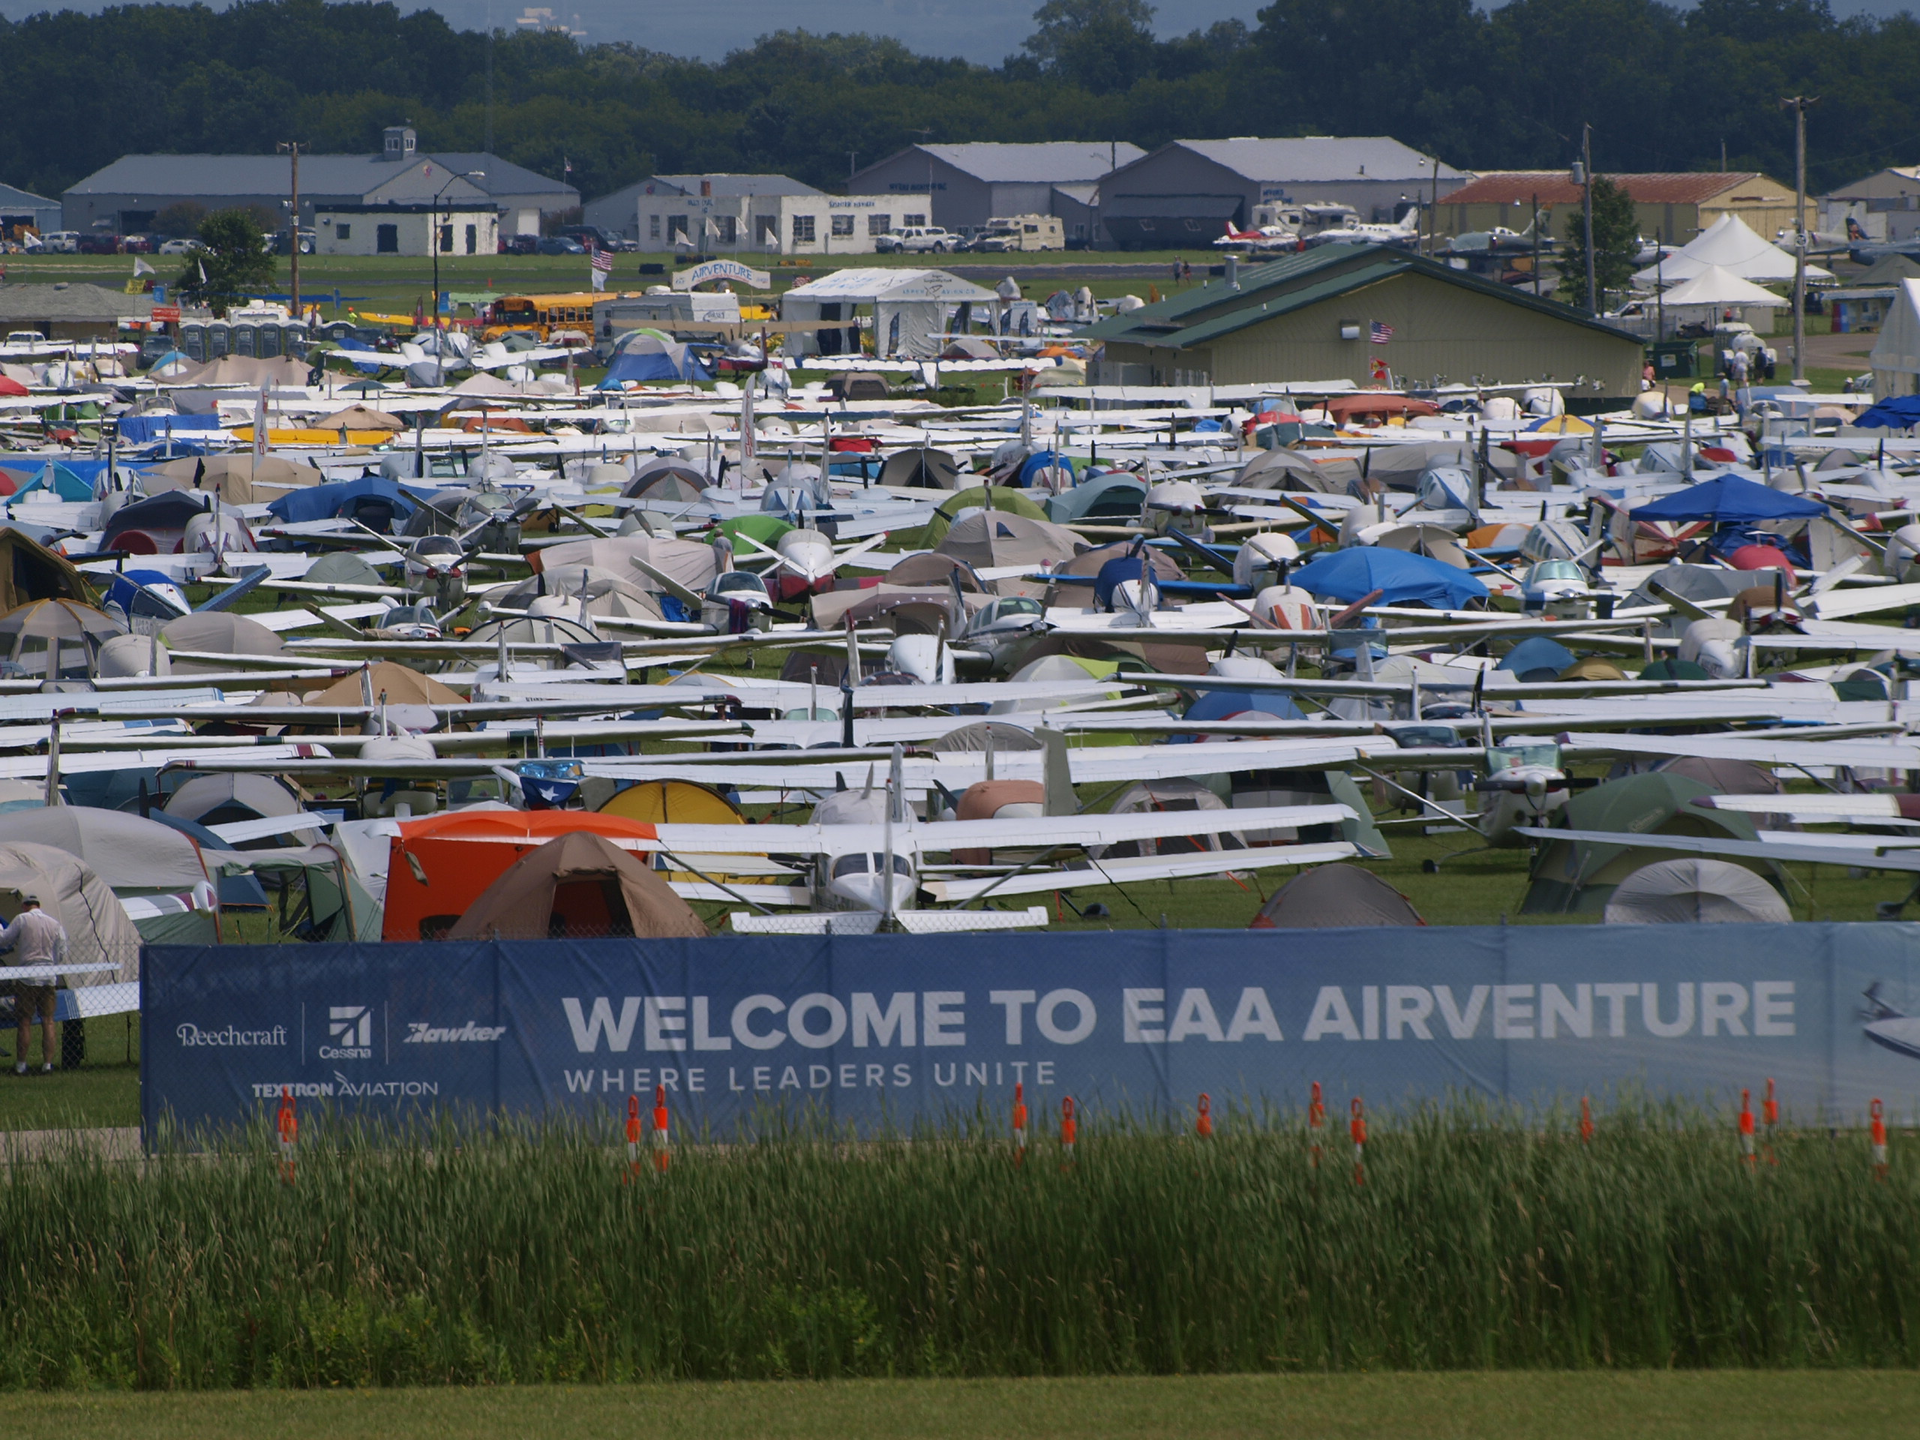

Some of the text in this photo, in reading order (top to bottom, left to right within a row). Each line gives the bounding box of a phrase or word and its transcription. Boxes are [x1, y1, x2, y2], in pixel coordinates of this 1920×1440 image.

[692, 263, 753, 281] AIRVENTURE
[561, 981, 1796, 1053] WELCOME TO EAA AIRVENTURE
[176, 1023, 287, 1046] Beechcraft
[402, 1021, 507, 1043] Hawker
[318, 1045, 371, 1060] Cessna
[564, 1060, 1056, 1093] WHERE LEADERS UNITE
[251, 1081, 438, 1098] TEXTRON AVIATION
